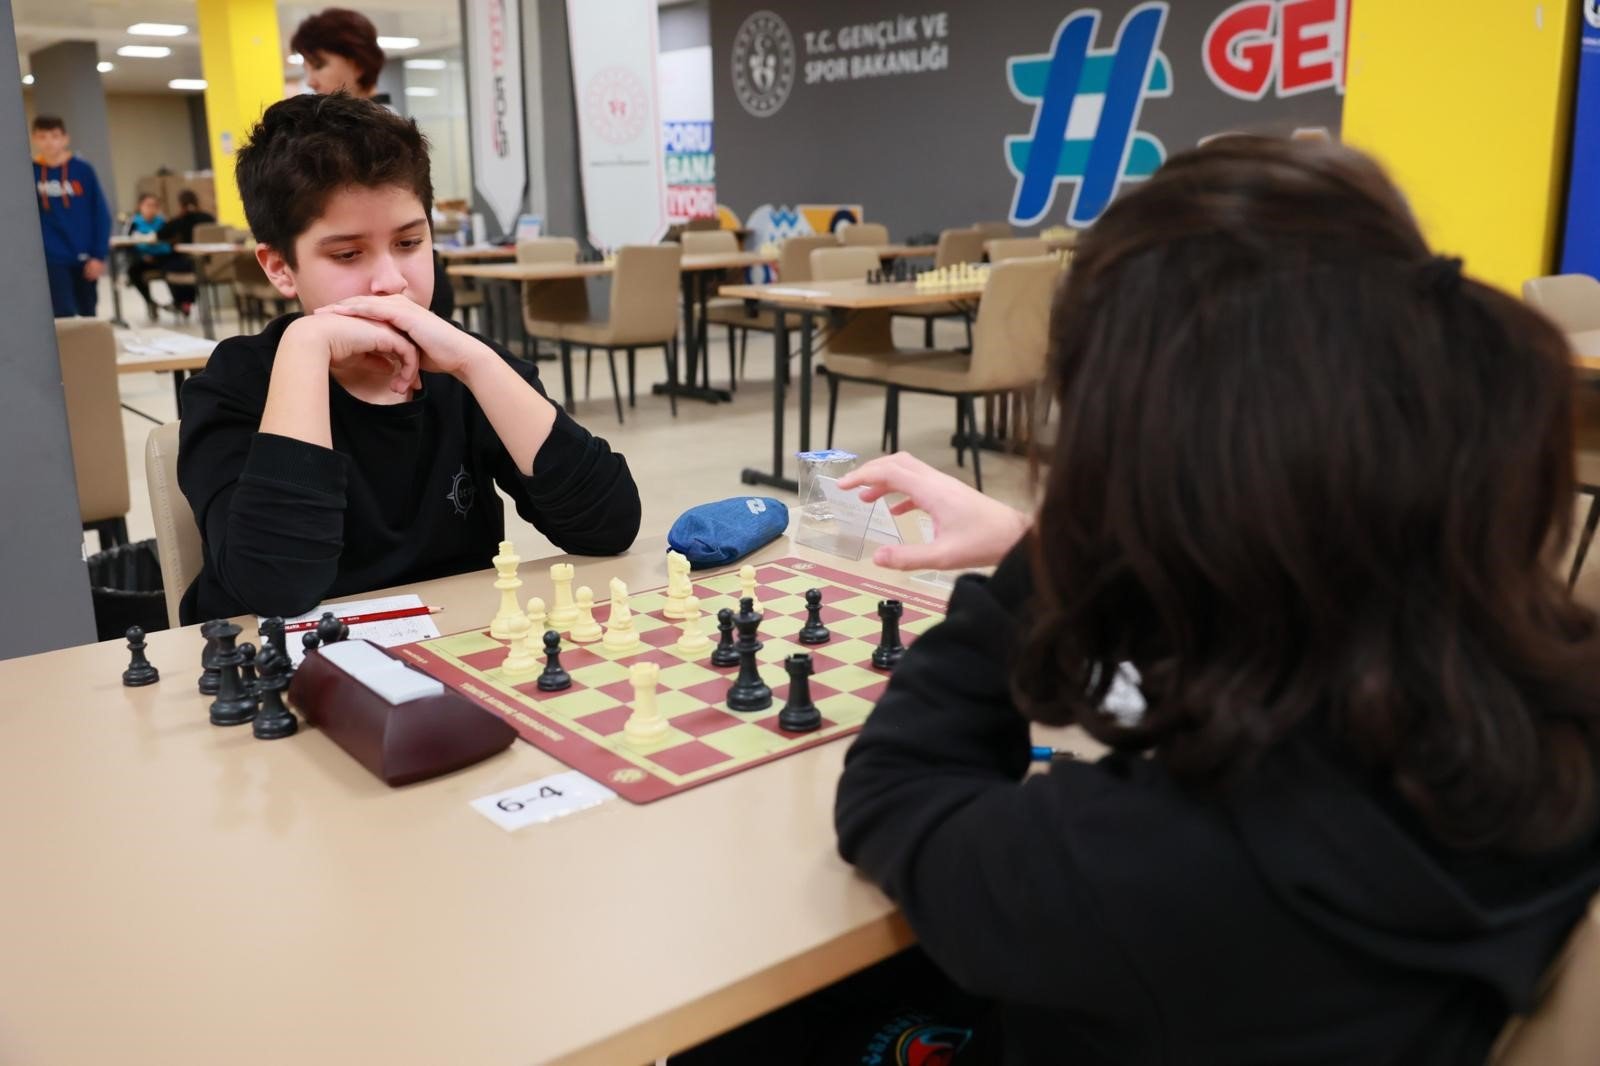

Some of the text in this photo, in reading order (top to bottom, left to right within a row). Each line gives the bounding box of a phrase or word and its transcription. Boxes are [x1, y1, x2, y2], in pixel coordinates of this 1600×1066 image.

[838, 14, 918, 50] GENÇLİK
[921, 12, 948, 39] VE
[1202, 0, 1350, 100] GE
[804, 41, 949, 84] SPOR BAKANLIĞI
[496, 786, 563, 812] 6-4
